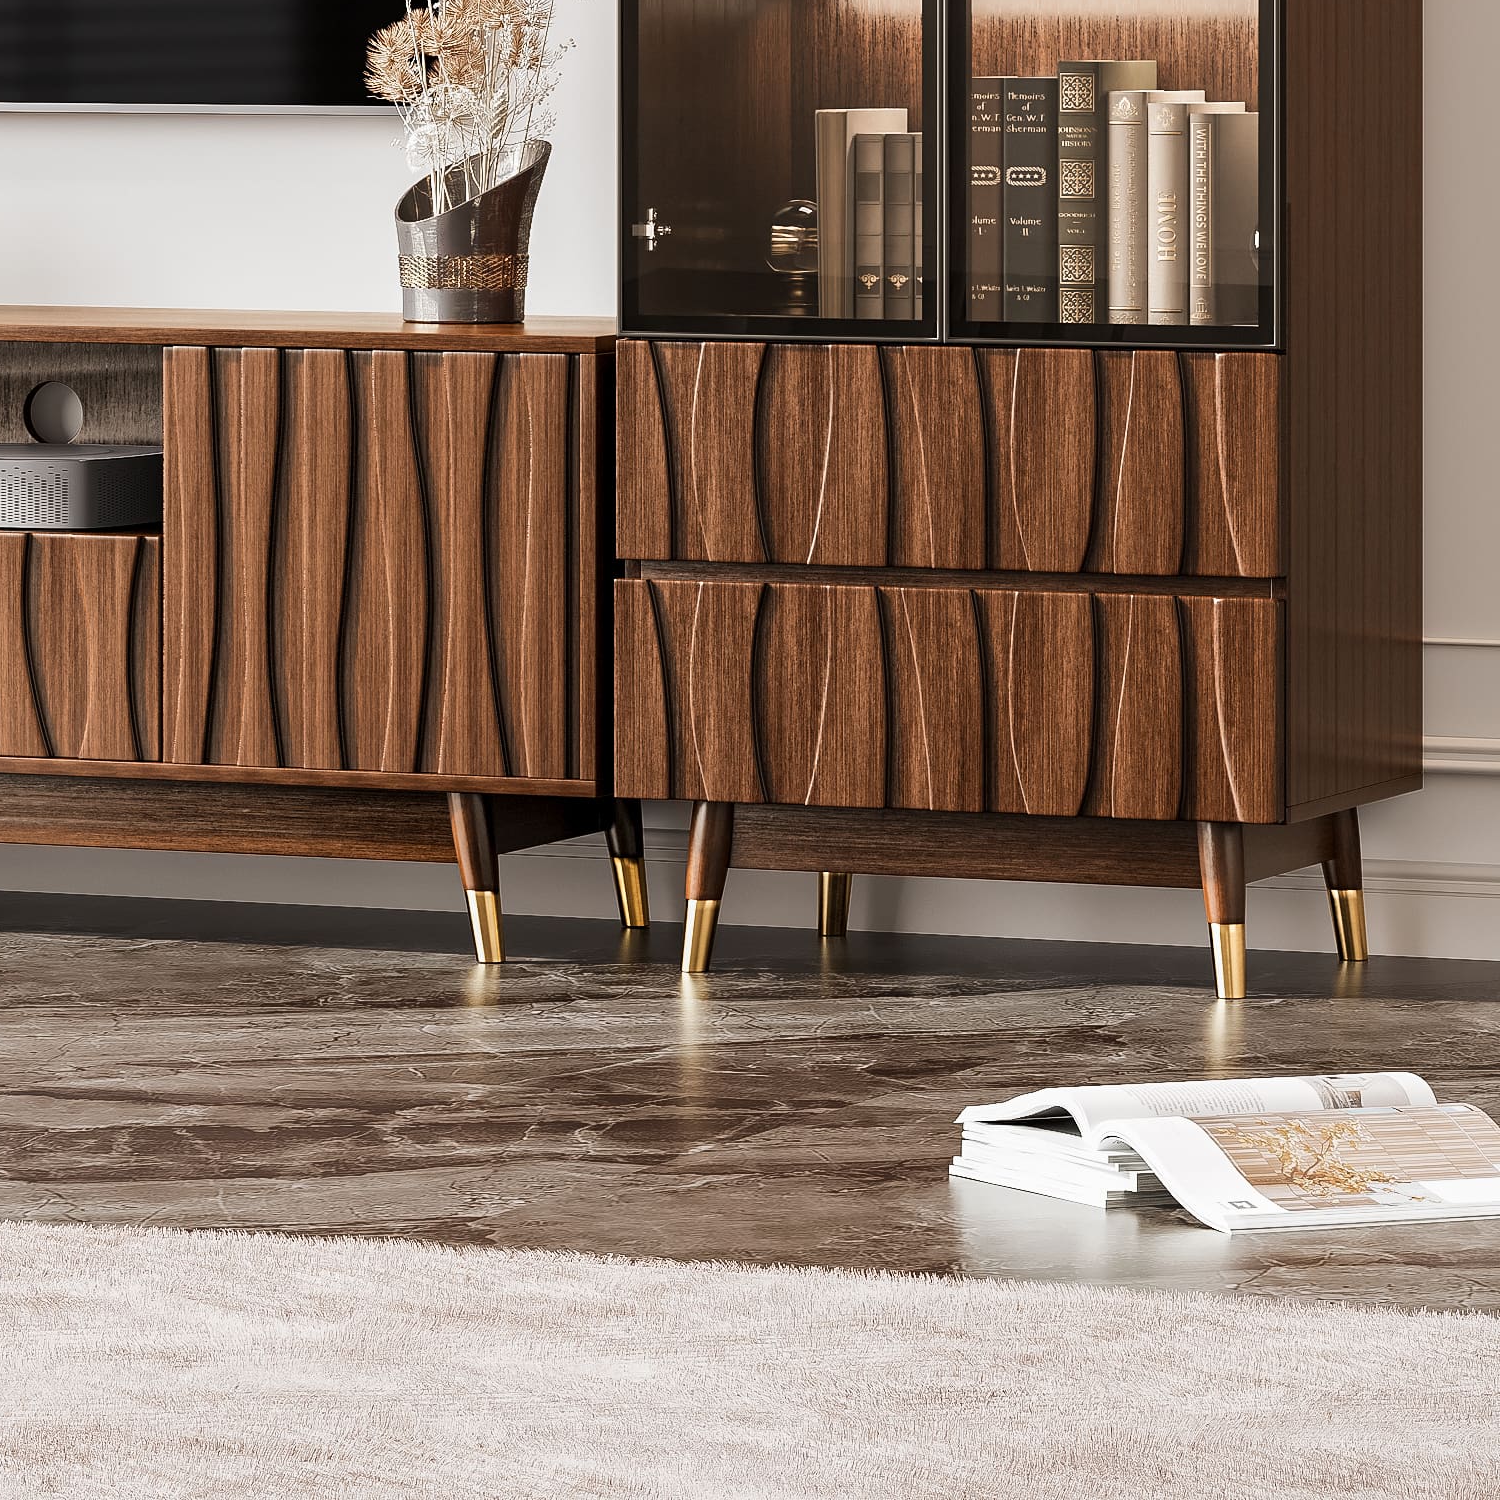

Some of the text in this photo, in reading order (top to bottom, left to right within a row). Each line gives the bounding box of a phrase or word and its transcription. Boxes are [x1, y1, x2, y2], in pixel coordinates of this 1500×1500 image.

[1008, 92, 1046, 101] Memoirs
[976, 101, 987, 111] of
[1021, 101, 1032, 112] of
[1006, 124, 1047, 133] Sherman
[1195, 128, 1207, 280] WITH THE THINGS WE LOVE
[1009, 216, 1042, 226] Volume
[1156, 190, 1178, 262] HOME
